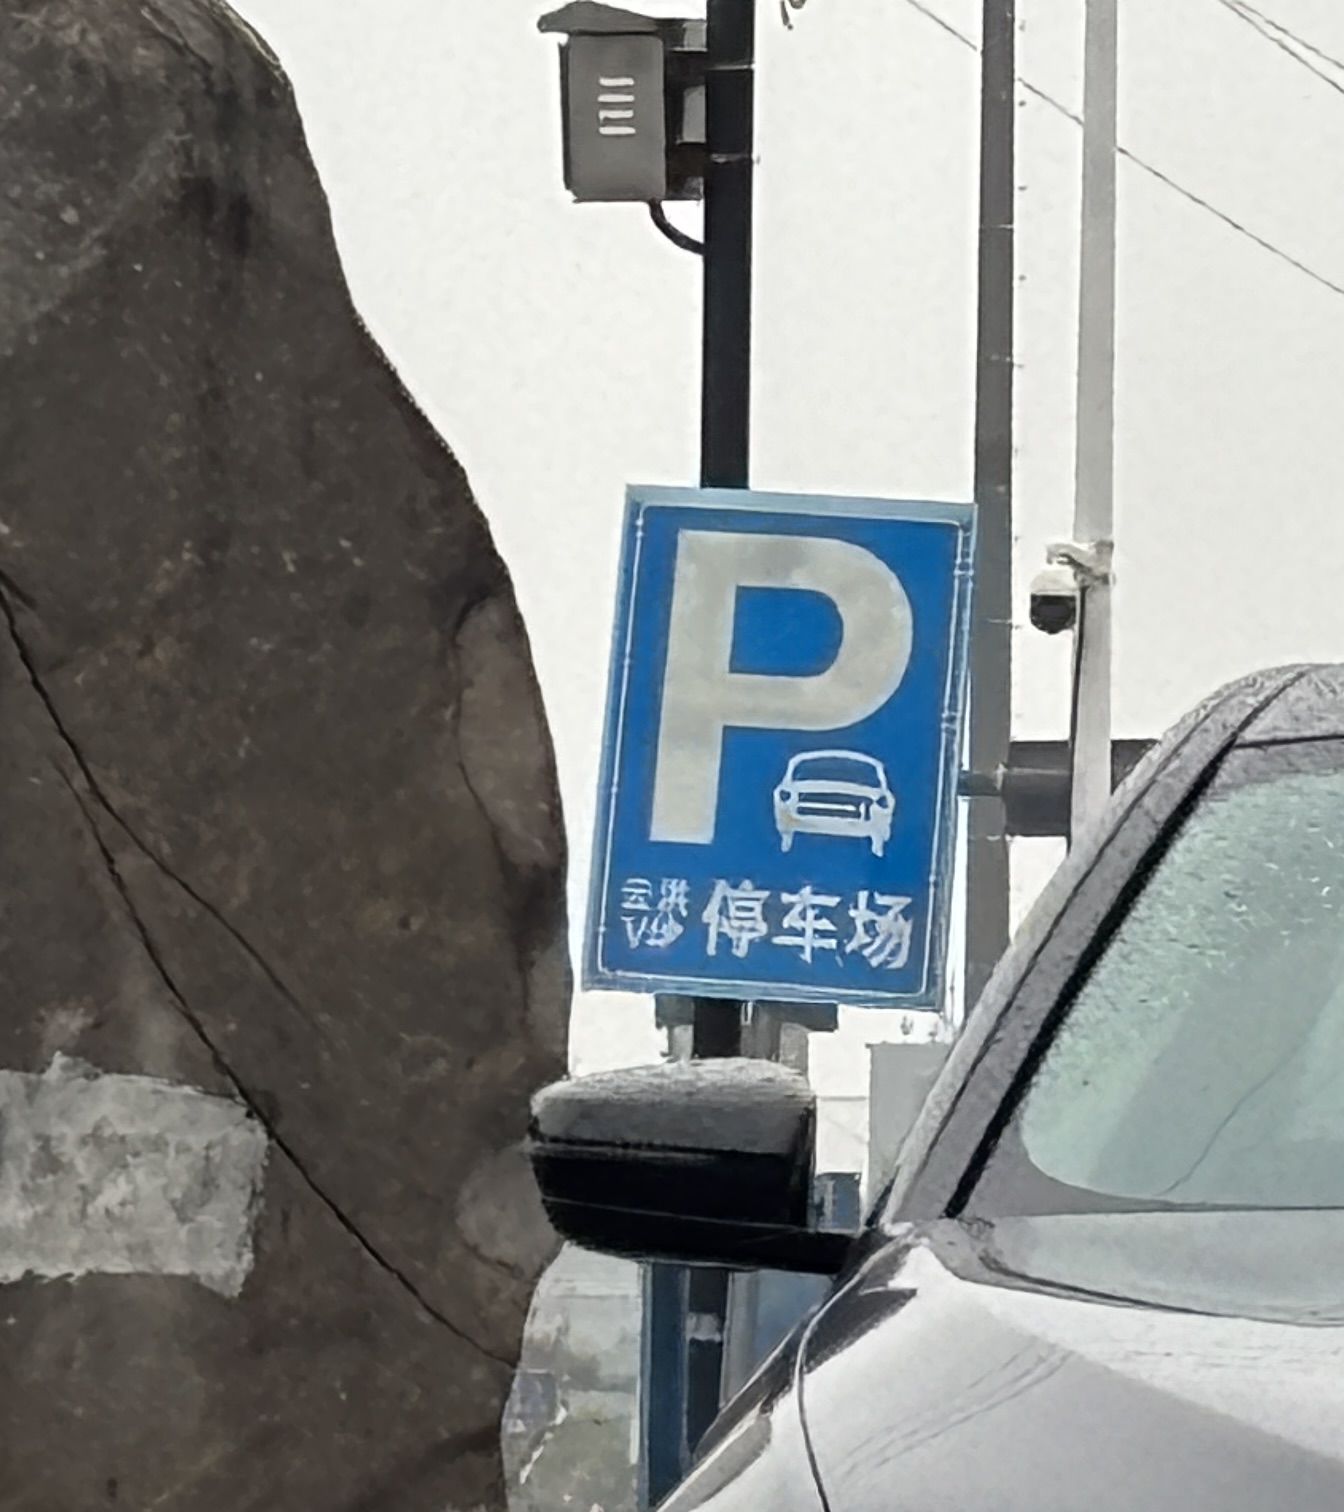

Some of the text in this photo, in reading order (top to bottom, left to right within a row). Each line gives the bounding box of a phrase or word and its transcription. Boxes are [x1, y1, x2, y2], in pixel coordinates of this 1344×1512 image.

[649, 528, 914, 845] P
[701, 877, 914, 970] 停车场
